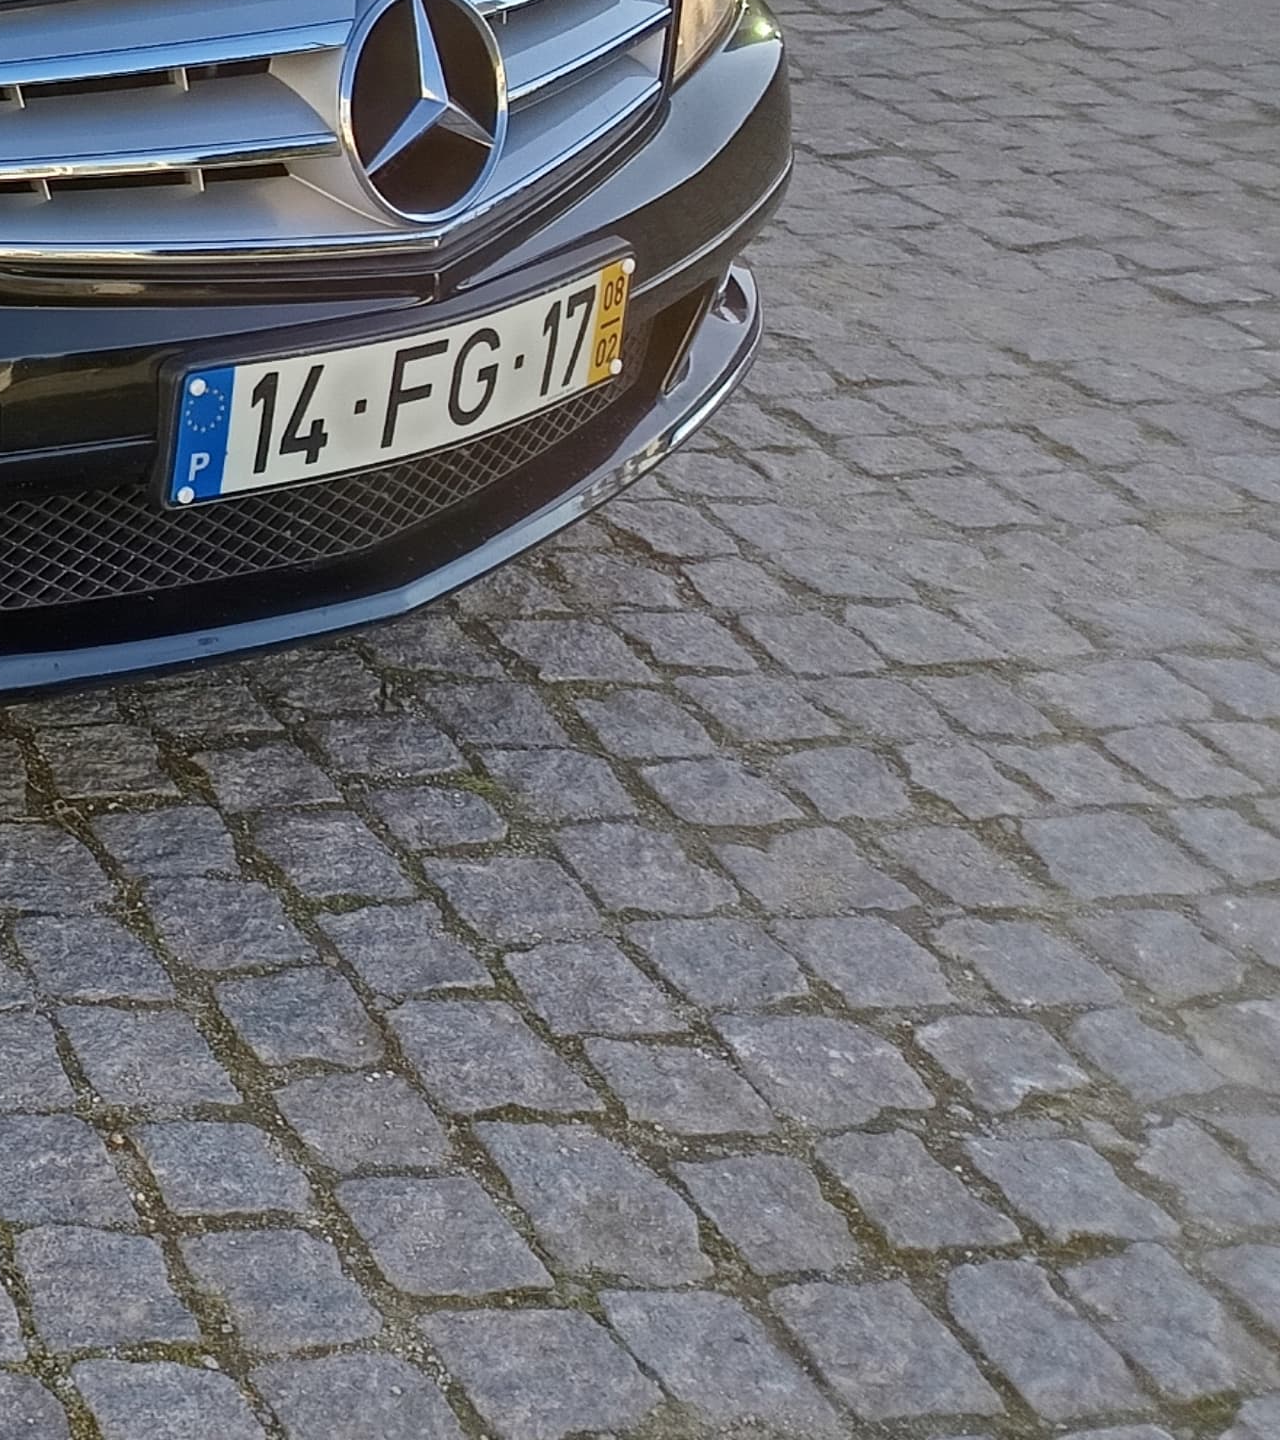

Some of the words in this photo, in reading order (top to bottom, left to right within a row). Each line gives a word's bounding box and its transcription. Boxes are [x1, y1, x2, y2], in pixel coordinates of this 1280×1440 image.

[604, 276, 624, 311] 08
[595, 333, 617, 367] 02
[188, 453, 210, 481] P
